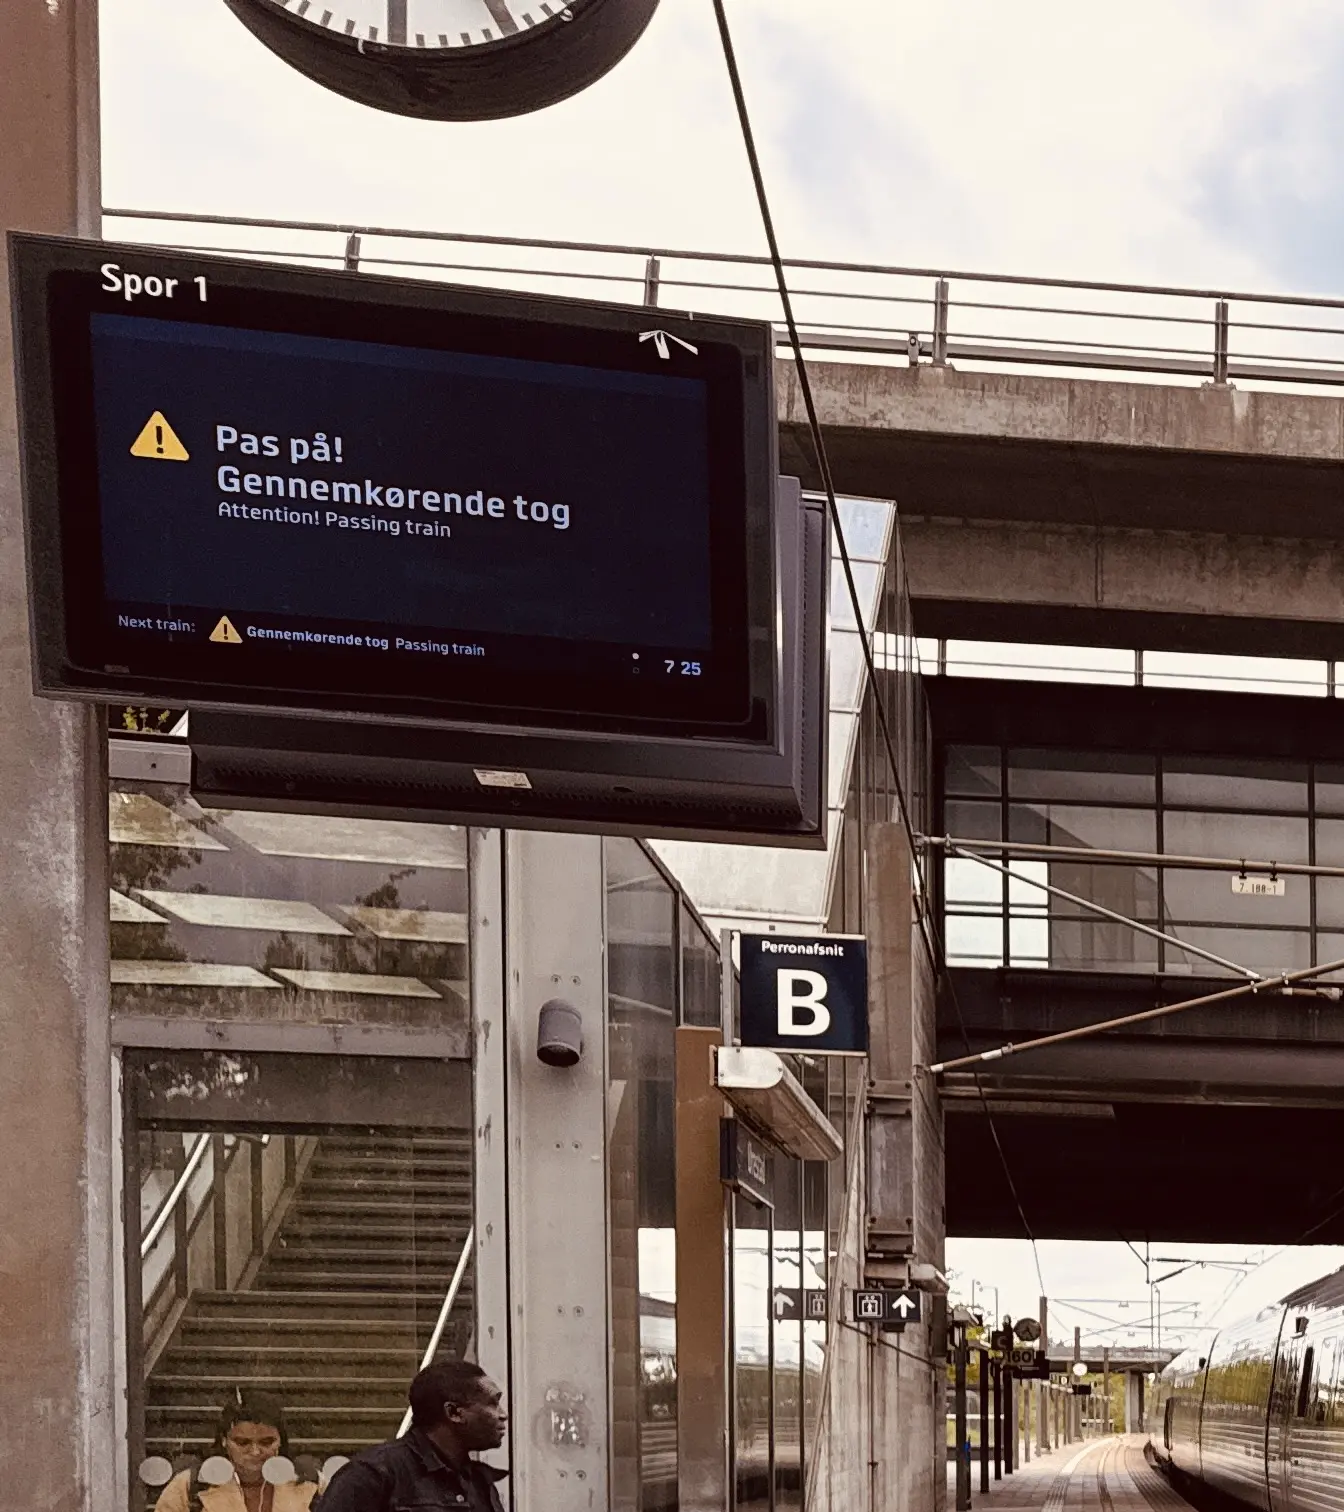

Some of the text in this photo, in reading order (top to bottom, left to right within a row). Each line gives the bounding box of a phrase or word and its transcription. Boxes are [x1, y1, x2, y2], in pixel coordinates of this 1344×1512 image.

[100, 263, 207, 302] Spor 1
[216, 425, 344, 464] Pas på!
[217, 465, 570, 530] Gennemkørende tog
[218, 501, 451, 538] Attention! Passing train
[118, 614, 153, 630] Next
[156, 618, 196, 633] train:
[365, 636, 389, 650] tog
[395, 637, 449, 655] Passing
[452, 642, 485, 657] train
[761, 940, 844, 957] Perronafsnit
[777, 968, 831, 1036] B
